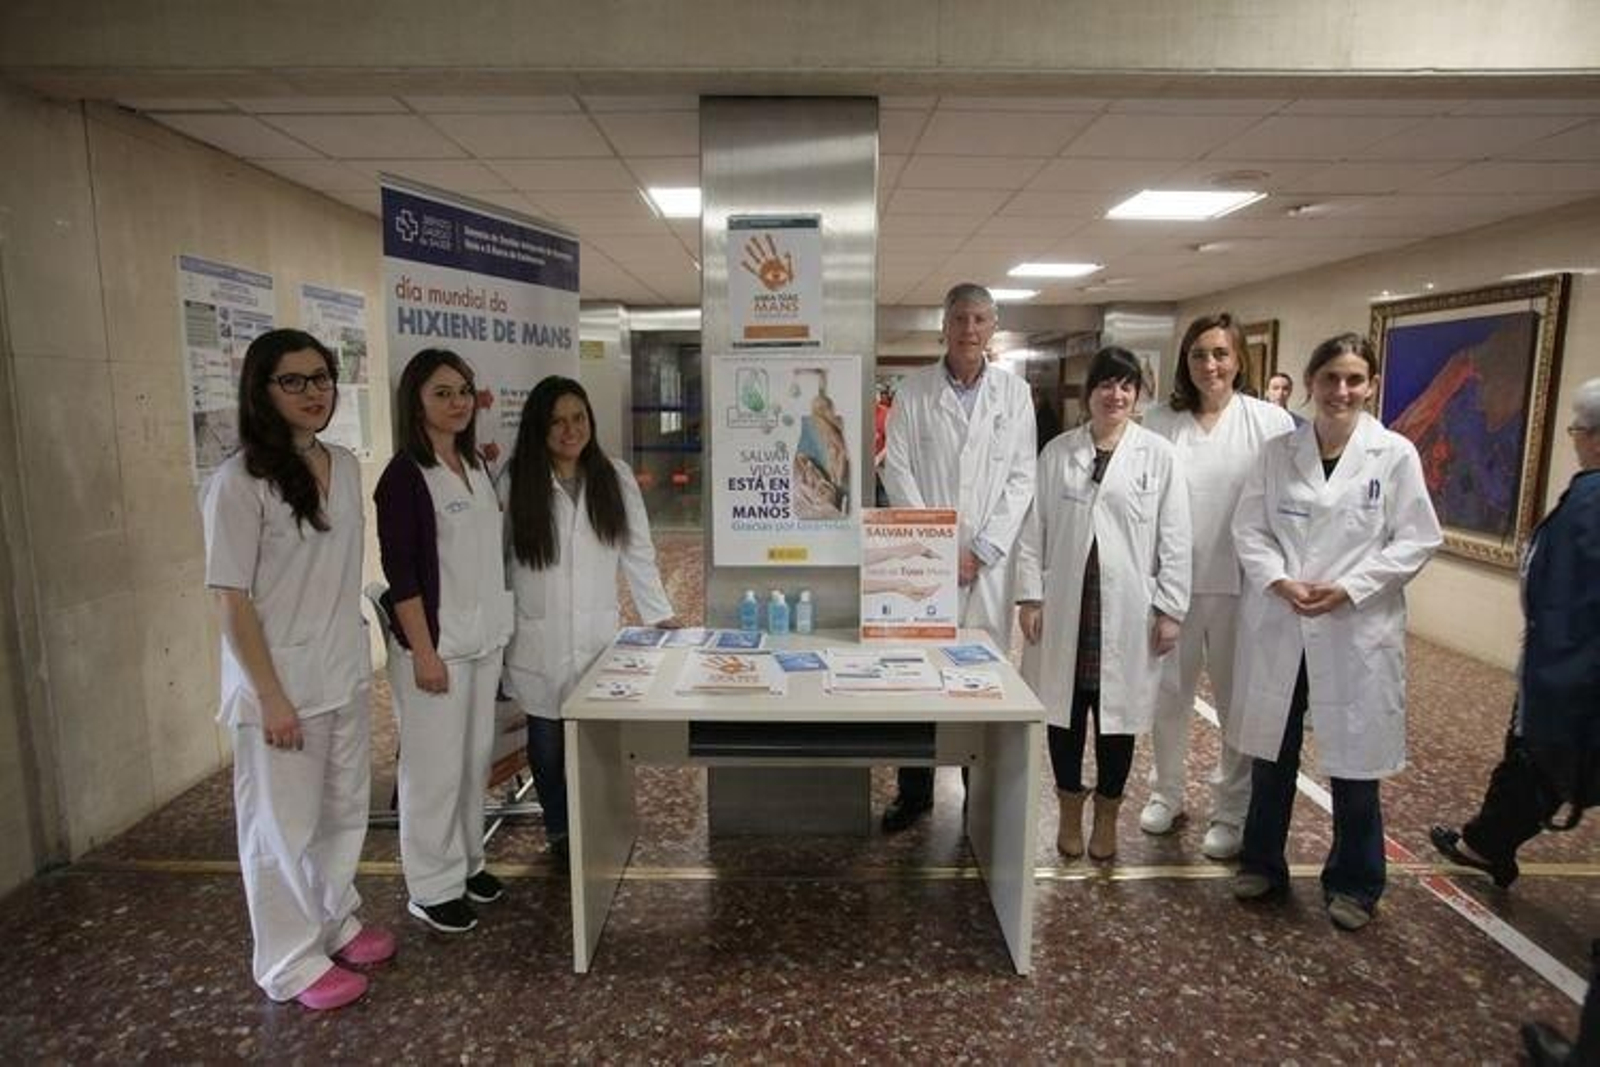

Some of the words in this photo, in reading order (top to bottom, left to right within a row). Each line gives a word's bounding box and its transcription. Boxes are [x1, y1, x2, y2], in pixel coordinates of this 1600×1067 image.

[428, 283, 486, 310] mundial
[489, 291, 508, 313] da
[398, 306, 488, 341] HIXIENE
[493, 318, 516, 344] DE
[521, 322, 572, 350] MANS
[750, 464, 789, 476] VIDAS
[769, 477, 789, 490] EN
[760, 492, 790, 504] TUS
[732, 506, 790, 519] MANOS
[866, 527, 912, 538] SALVAN
[916, 527, 955, 538] VIDAS
